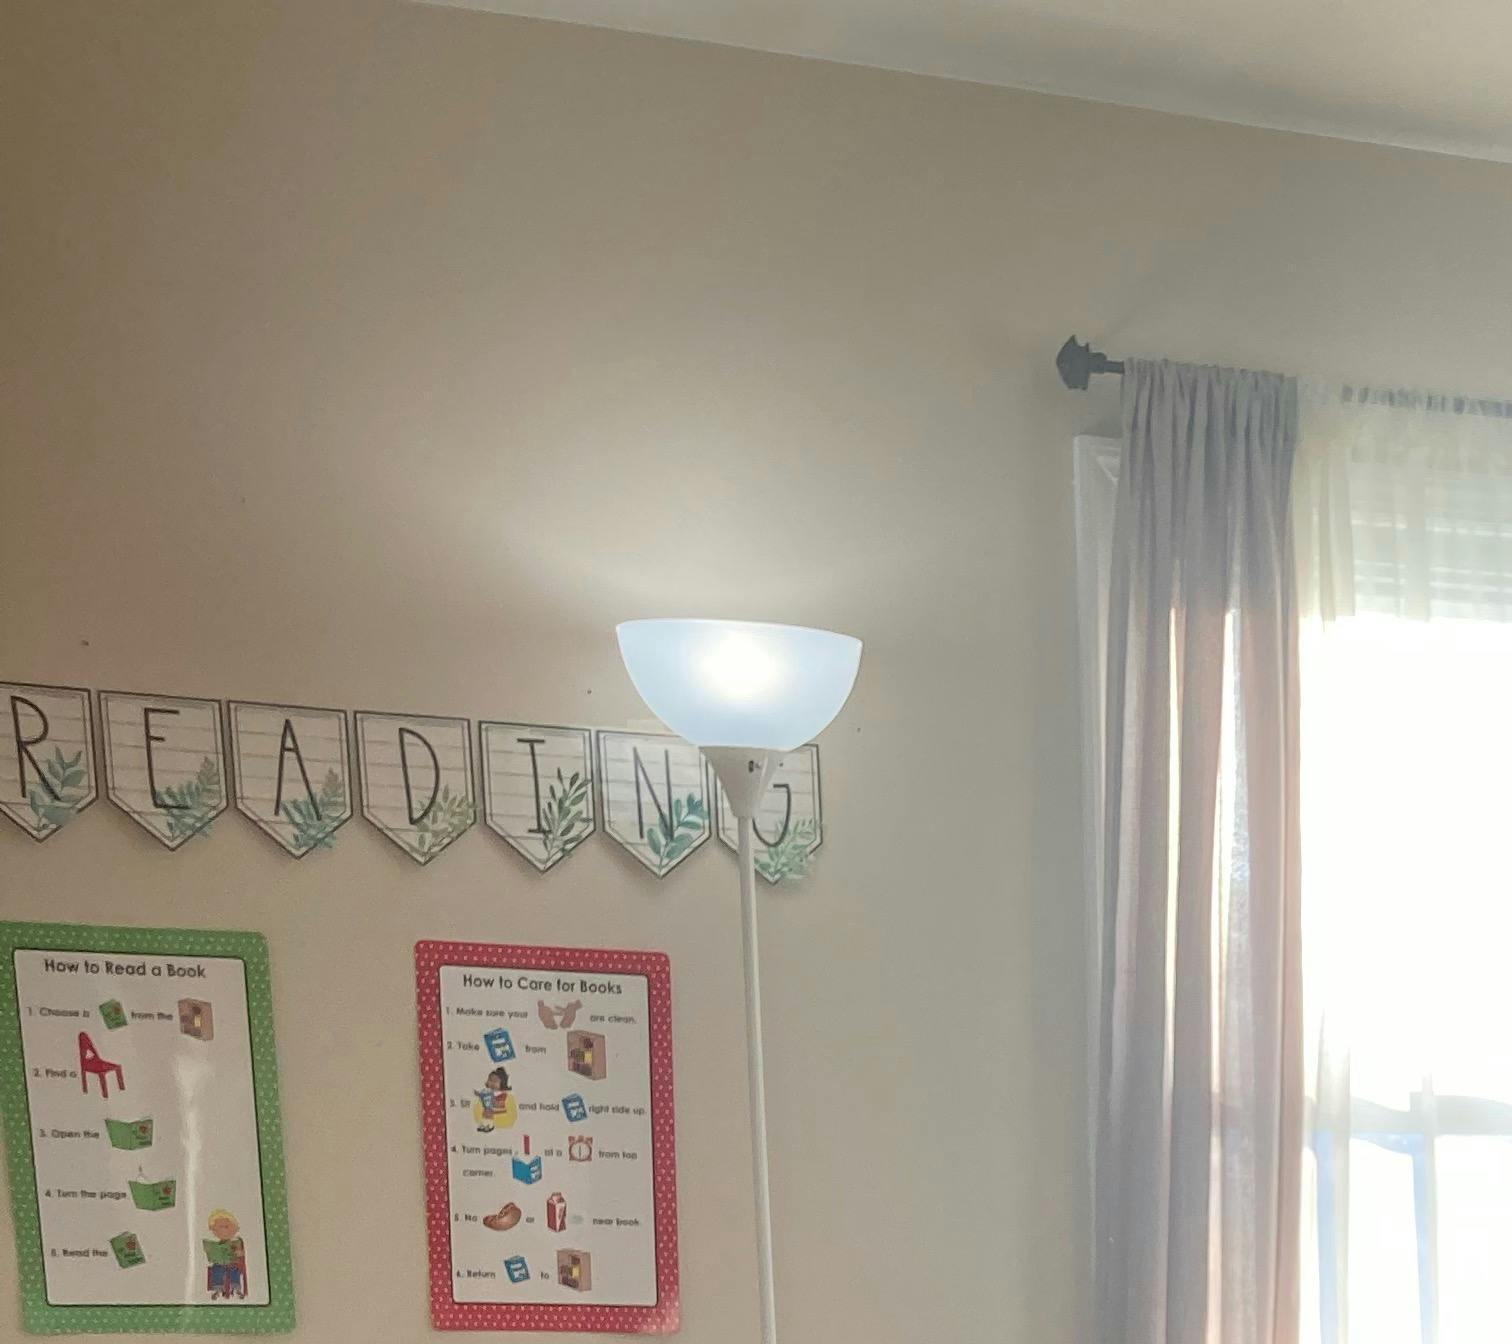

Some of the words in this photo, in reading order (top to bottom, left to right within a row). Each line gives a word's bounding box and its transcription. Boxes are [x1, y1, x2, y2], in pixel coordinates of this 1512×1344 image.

[44, 959, 79, 974] How
[85, 960, 99, 974] to
[106, 960, 146, 977] Read
[152, 965, 162, 977] a
[168, 961, 206, 978] Book
[463, 974, 495, 988] How
[500, 975, 513, 990] to
[518, 977, 552, 991] Care
[557, 978, 575, 993] for
[581, 979, 622, 995] Books
[456, 1008, 483, 1017] Make
[507, 1011, 528, 1020] your
[590, 1015, 605, 1023] are
[457, 1042, 480, 1051] Take
[525, 1045, 547, 1054] from
[46, 1068, 67, 1078] Find
[519, 1102, 536, 1111] and
[539, 1103, 560, 1112] hold
[589, 1105, 609, 1115] right
[611, 1105, 630, 1115] side
[51, 1130, 81, 1140] Open
[57, 1189, 77, 1198] Turn
[100, 1192, 127, 1201] page
[467, 1270, 496, 1279] Return
[541, 1271, 549, 1280] to
